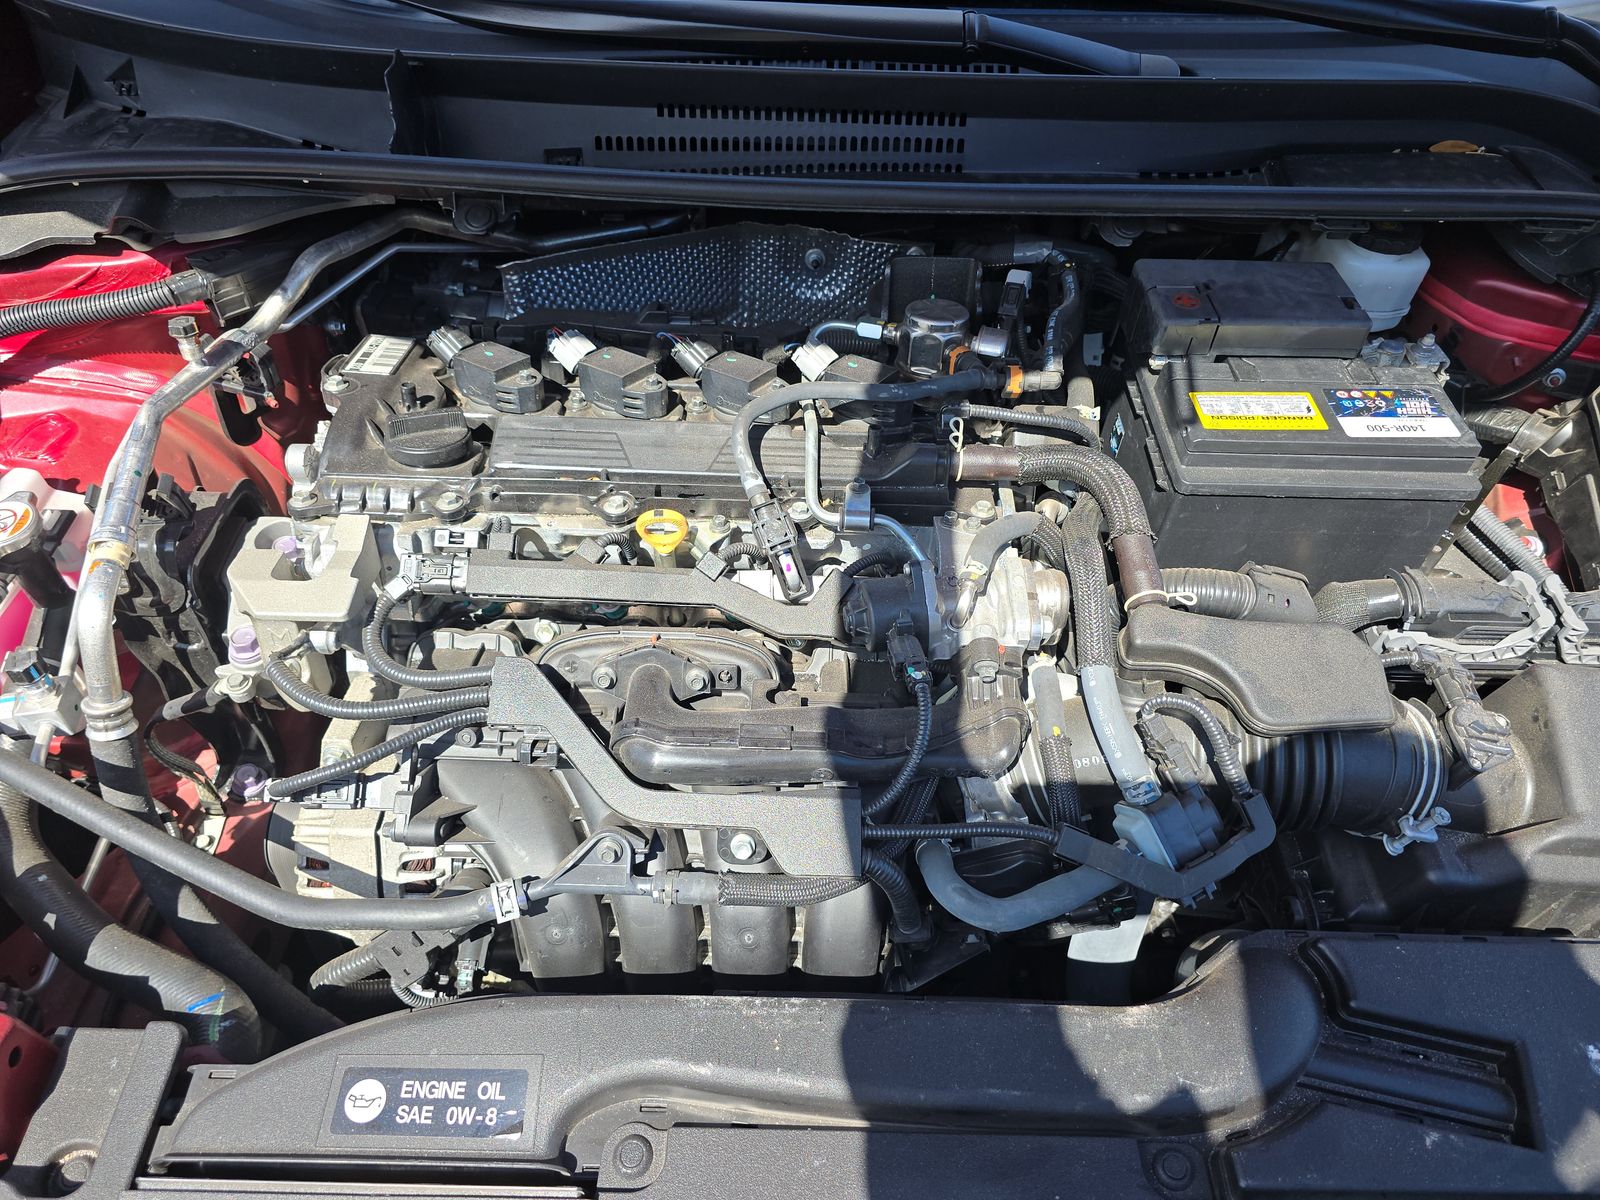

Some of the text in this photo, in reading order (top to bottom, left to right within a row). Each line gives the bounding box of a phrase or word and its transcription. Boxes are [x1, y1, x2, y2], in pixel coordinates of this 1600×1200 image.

[1366, 424, 1427, 433] 140R-500
[400, 1081, 506, 1101] ENGINE OIL
[396, 1106, 498, 1126] SAE 0W-8
